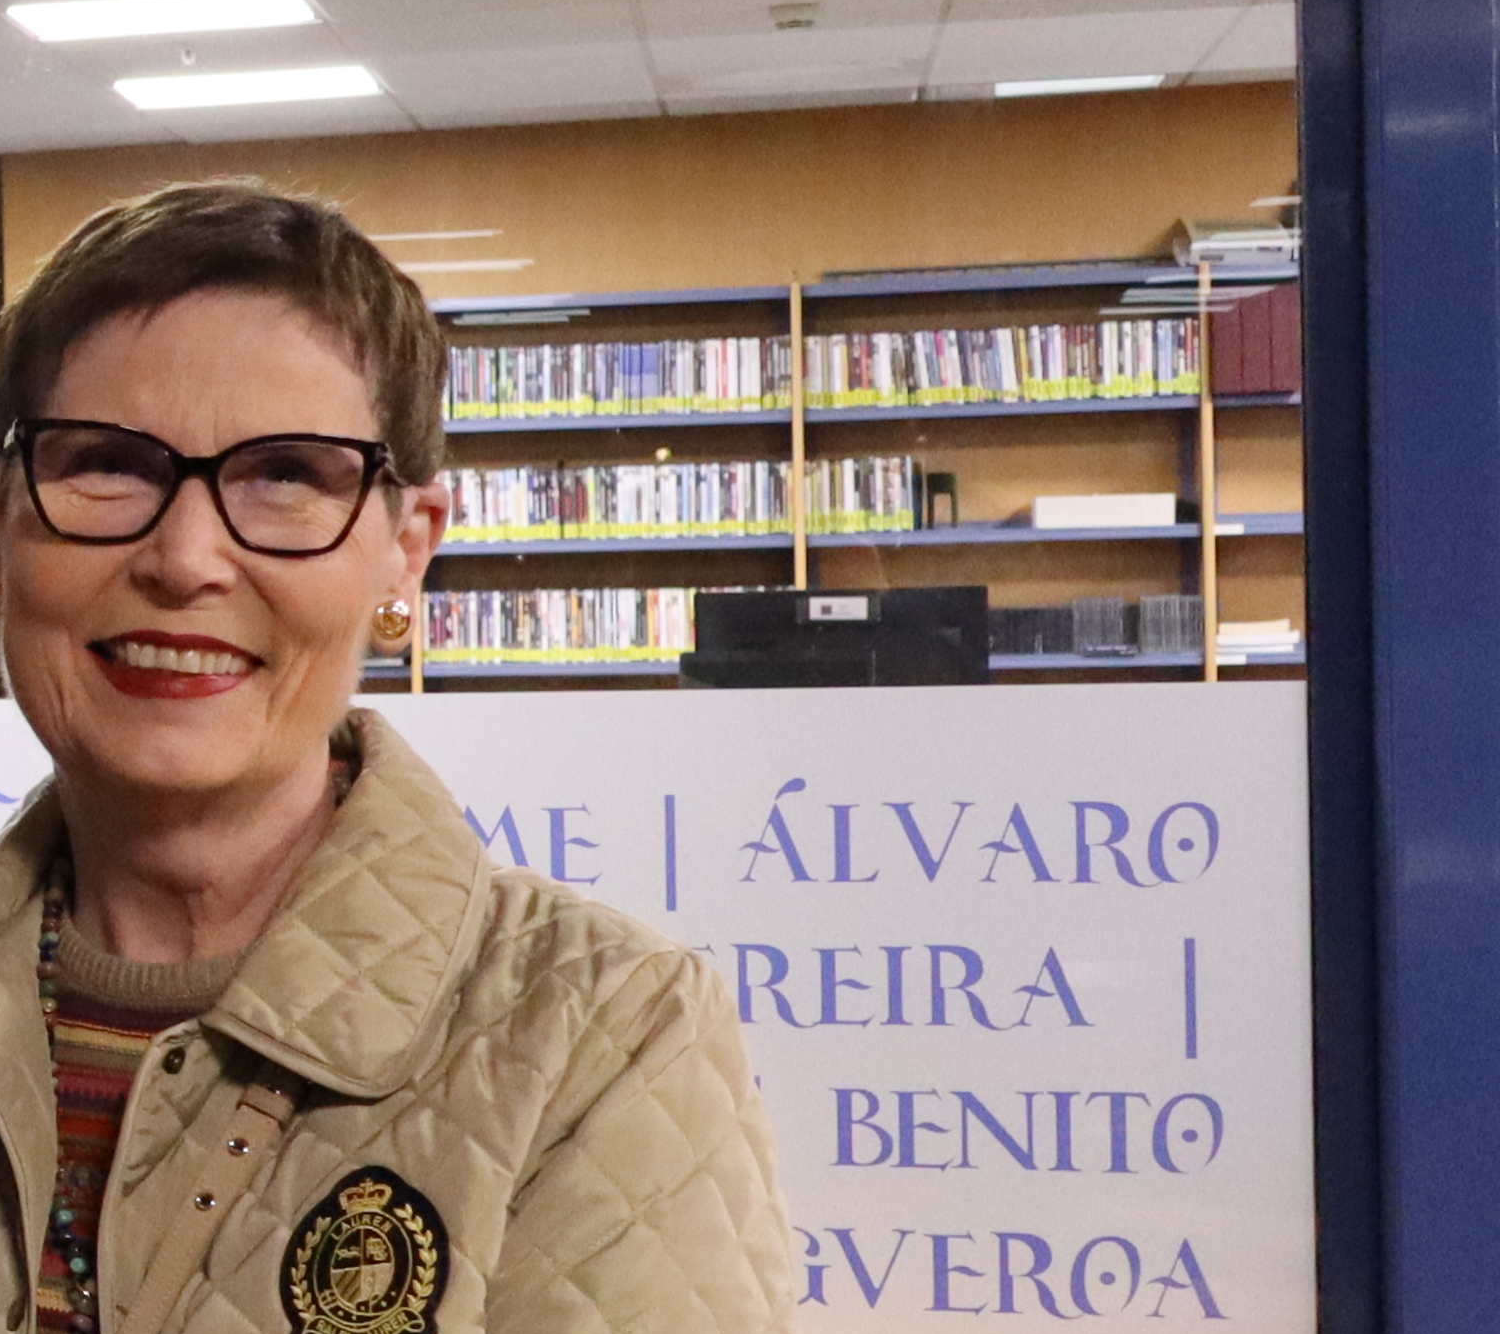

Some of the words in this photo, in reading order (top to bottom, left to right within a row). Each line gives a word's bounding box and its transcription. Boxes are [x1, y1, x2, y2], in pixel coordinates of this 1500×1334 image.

[738, 777, 1221, 888] ÁLVARO
[726, 943, 1097, 1031] REIRA
[829, 1087, 1225, 1174] BENITO
